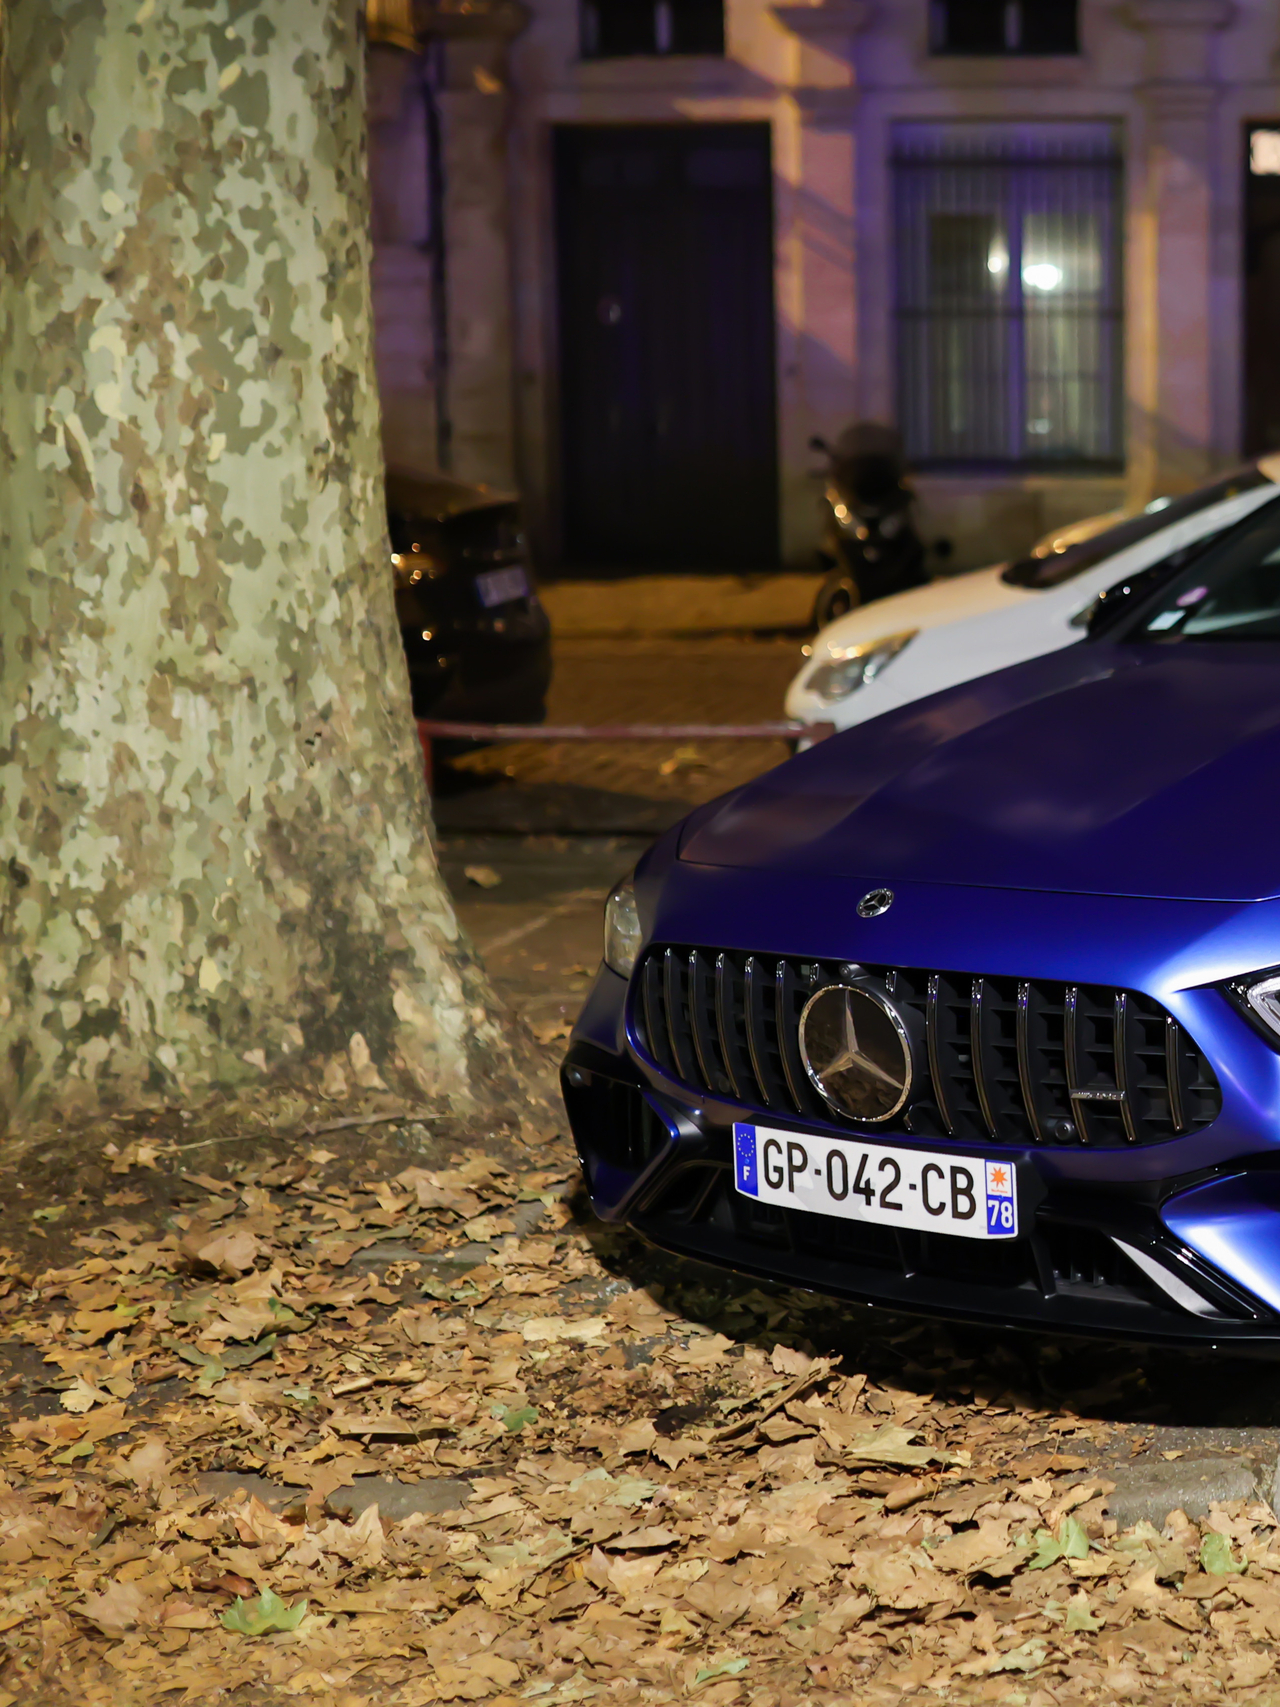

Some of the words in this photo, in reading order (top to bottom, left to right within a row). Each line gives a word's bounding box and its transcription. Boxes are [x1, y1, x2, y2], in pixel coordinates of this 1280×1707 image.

[743, 1166, 750, 1180] F
[763, 1138, 977, 1220] GP-042-CB
[987, 1199, 1013, 1229] 78
